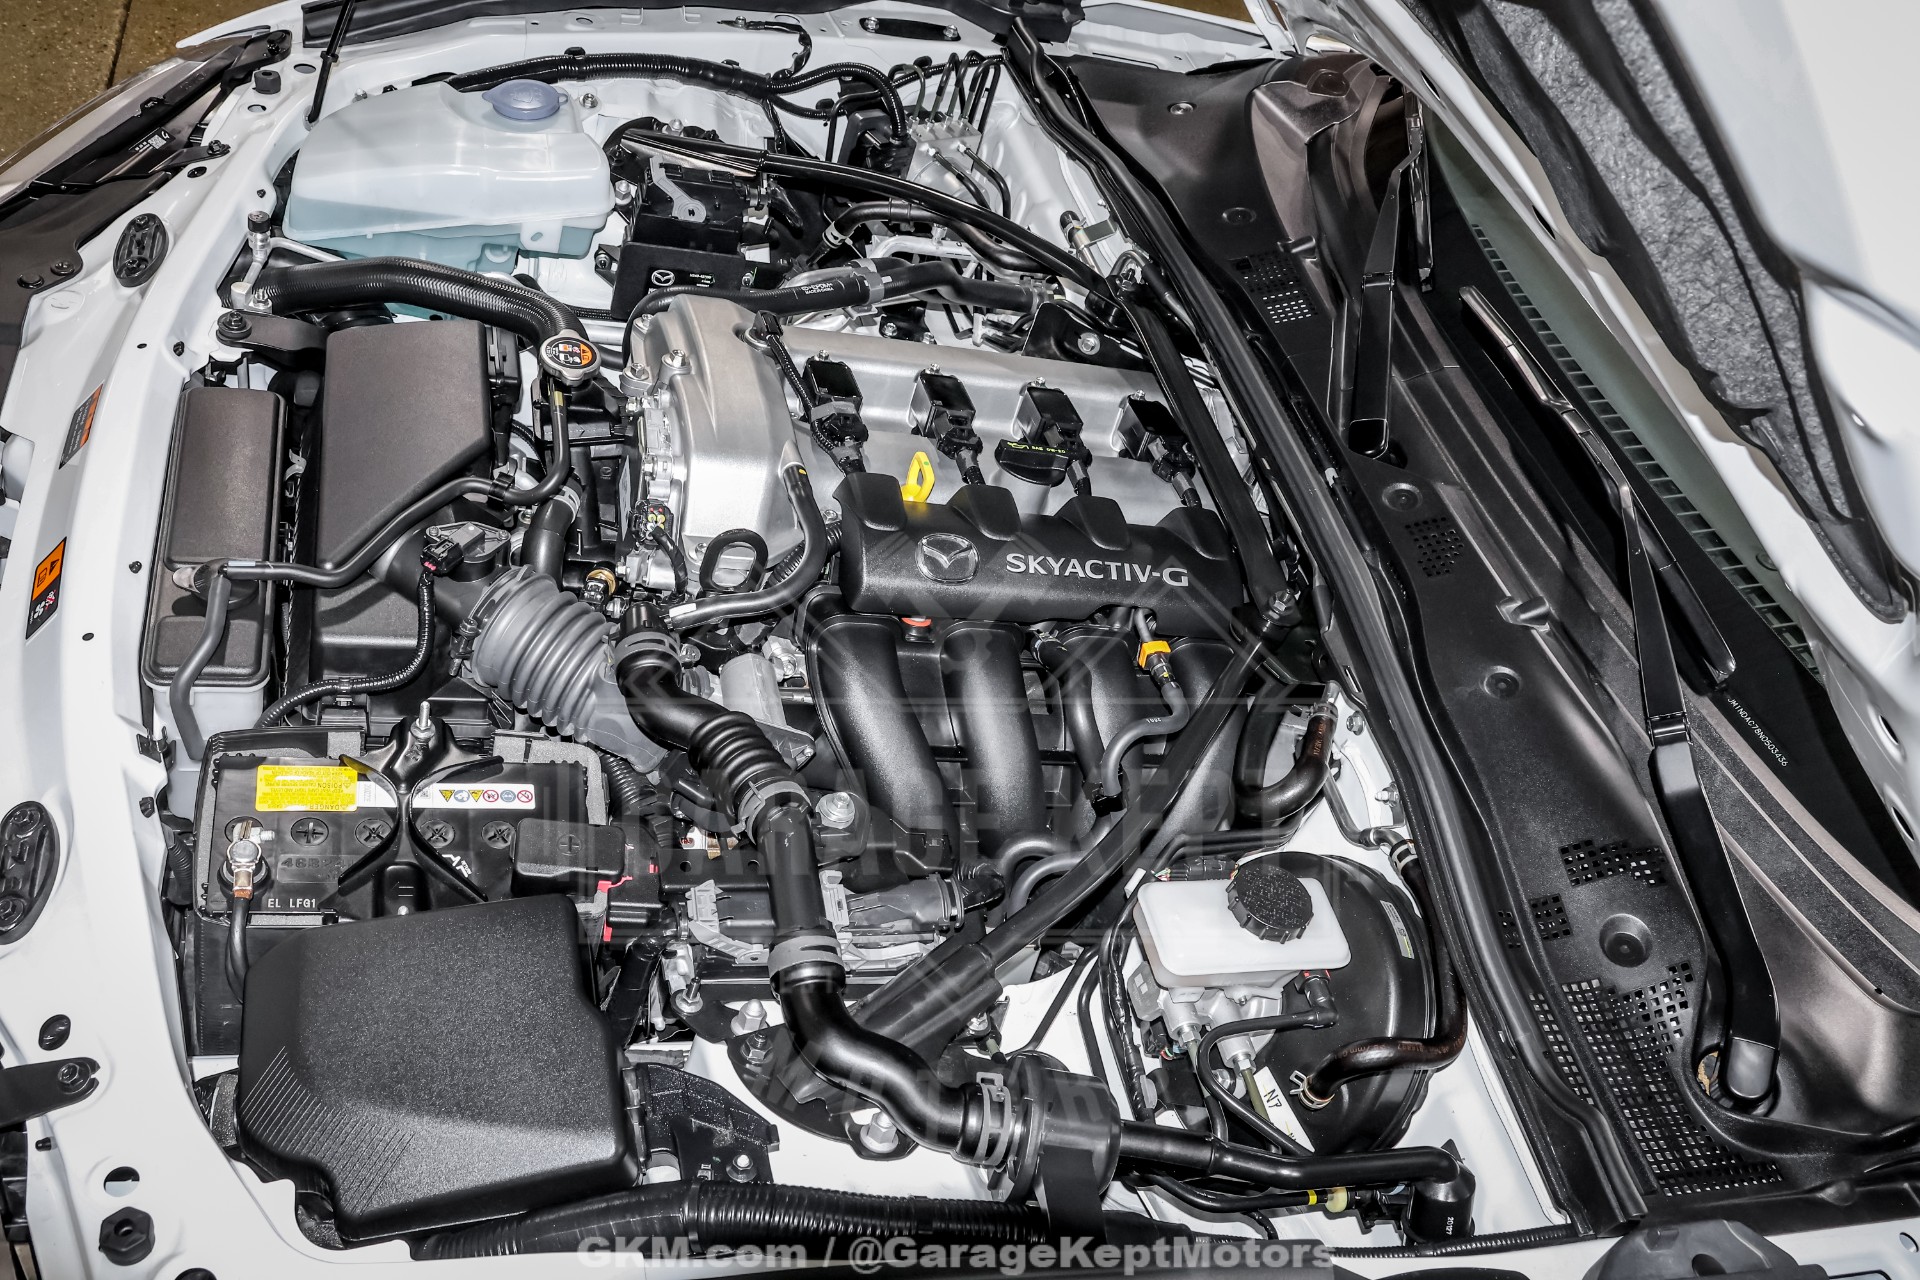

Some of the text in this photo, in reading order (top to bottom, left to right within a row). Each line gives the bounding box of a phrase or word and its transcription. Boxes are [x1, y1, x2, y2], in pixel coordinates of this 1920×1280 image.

[1006, 553, 1189, 588] SKYACTIV-G
[267, 898, 316, 908] EL LFG1
